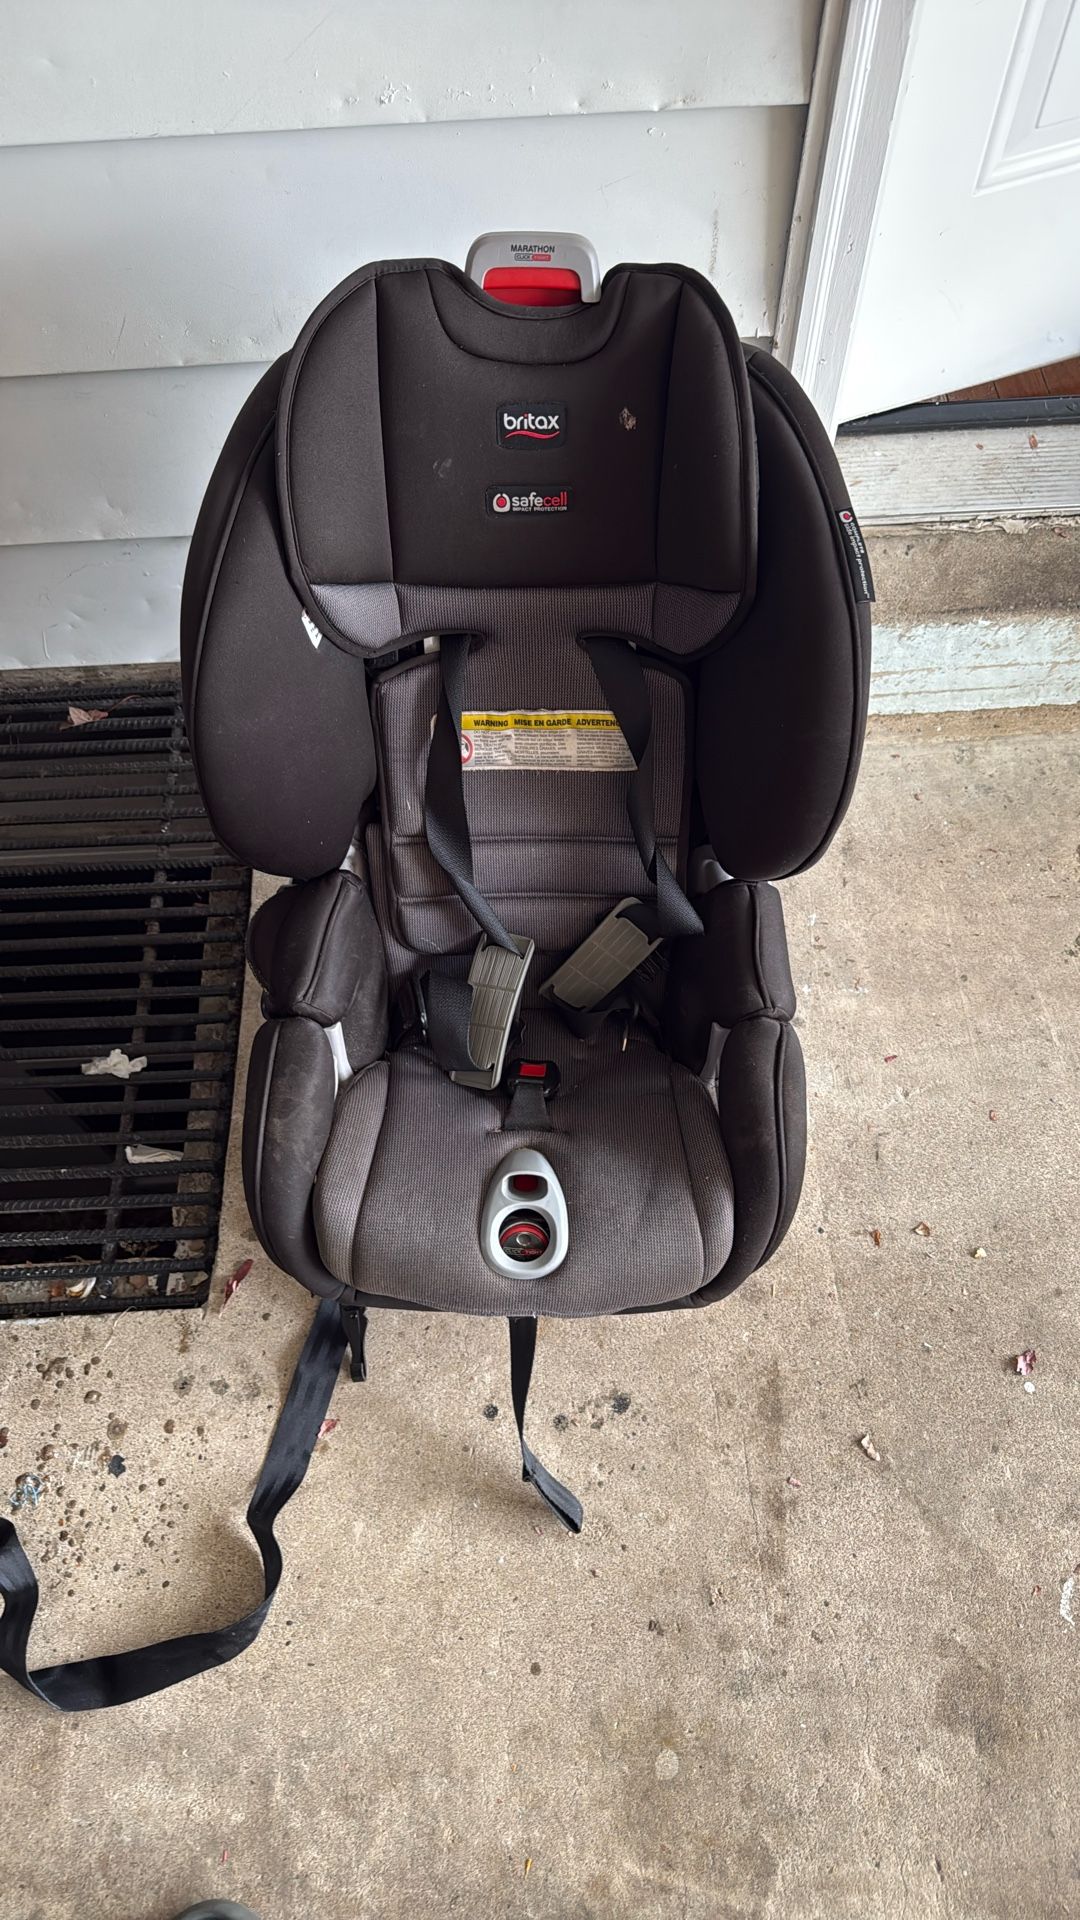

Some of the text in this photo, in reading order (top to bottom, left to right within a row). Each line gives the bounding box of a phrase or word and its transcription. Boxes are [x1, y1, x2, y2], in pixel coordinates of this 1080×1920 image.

[510, 244, 555, 253] MARATHON
[503, 413, 560, 430] britax
[511, 491, 567, 507] safecell
[844, 523, 852, 536] side
[849, 535, 861, 557] impact
[473, 719, 509, 727] WARNING
[513, 718, 533, 726] MISE
[545, 718, 572, 727] GARDE
